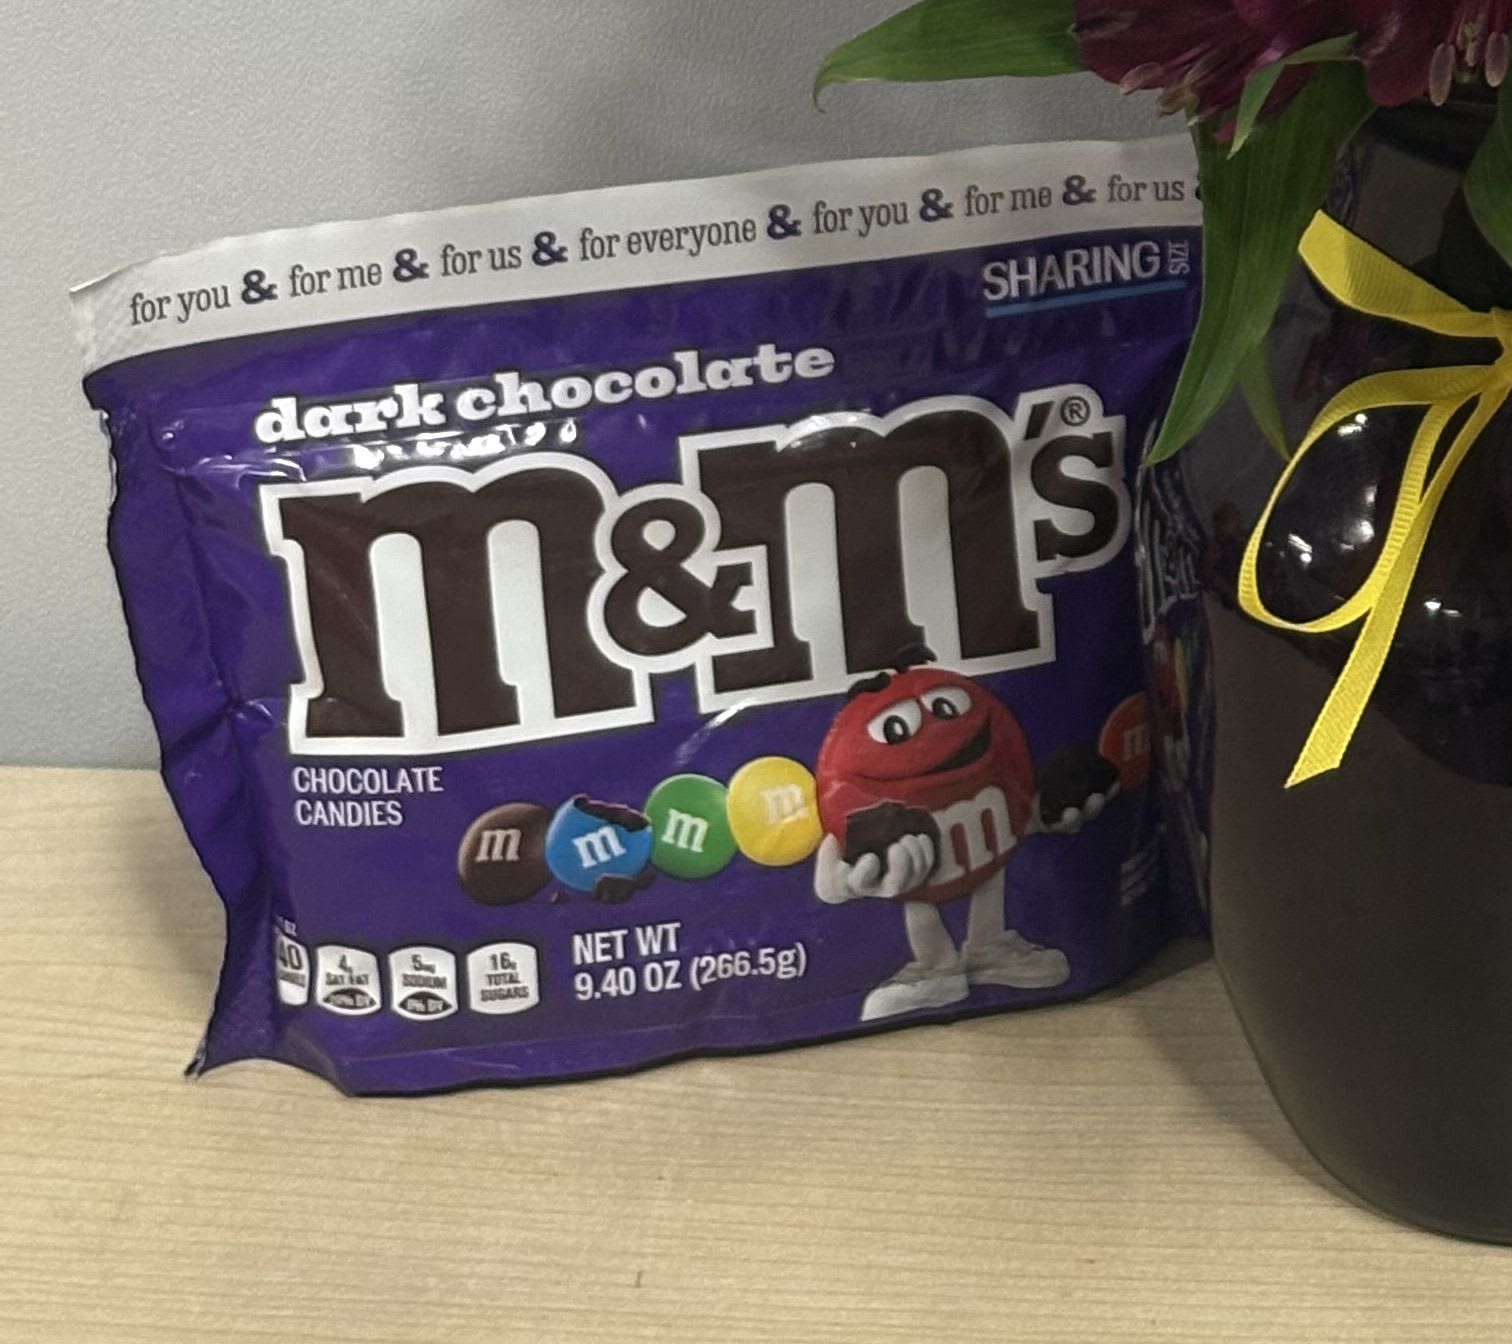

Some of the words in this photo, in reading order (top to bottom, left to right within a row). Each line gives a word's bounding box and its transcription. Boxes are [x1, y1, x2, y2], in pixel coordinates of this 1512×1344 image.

[130, 293, 171, 325] for
[177, 283, 231, 322] you
[241, 269, 277, 304] &
[289, 265, 331, 297] for
[338, 261, 382, 291] me
[393, 248, 429, 283] &
[440, 245, 482, 278] for
[488, 244, 522, 271] us
[531, 231, 568, 266] &
[580, 227, 620, 260] for
[627, 219, 757, 257] everyone
[767, 205, 801, 240] &
[813, 201, 853, 234] for
[859, 200, 909, 237] you
[919, 188, 953, 222] &
[965, 185, 1004, 216] for
[1010, 182, 1053, 209] me
[1062, 175, 1097, 205] &
[1107, 173, 1147, 202] for
[1153, 180, 1185, 201] us
[1168, 240, 1190, 274] SIZE
[983, 241, 1160, 301] SHARING
[254, 383, 446, 444] dark
[457, 343, 834, 421] chocolate
[293, 766, 444, 795] CHOCOLATE
[295, 800, 404, 827] CANDIES
[761, 784, 808, 825] m
[475, 829, 521, 862] m
[571, 826, 627, 869] m
[661, 809, 709, 853] m
[927, 785, 1017, 886] m
[572, 929, 628, 965] NET
[634, 922, 681, 956] WT
[574, 967, 636, 1001] 9.40
[643, 960, 682, 992] OZ
[689, 942, 807, 991] (266.5g)
